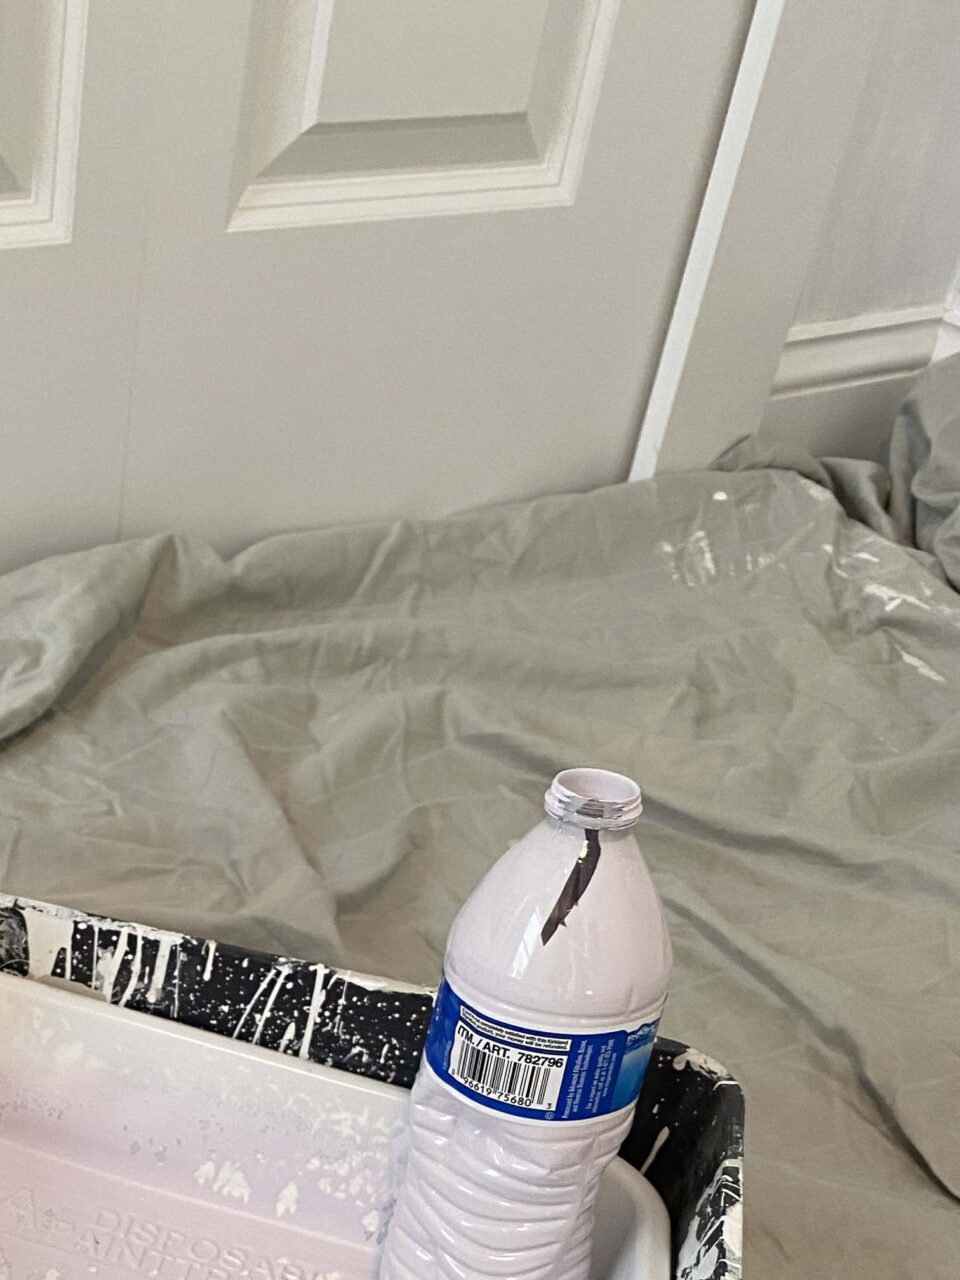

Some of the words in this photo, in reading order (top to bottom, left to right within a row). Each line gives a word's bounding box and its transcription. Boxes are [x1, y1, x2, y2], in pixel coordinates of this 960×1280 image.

[482, 1042, 510, 1059] ART.
[517, 1052, 564, 1068] 782796
[463, 1077, 492, 1096] 96619
[497, 1091, 532, 1107] 75680
